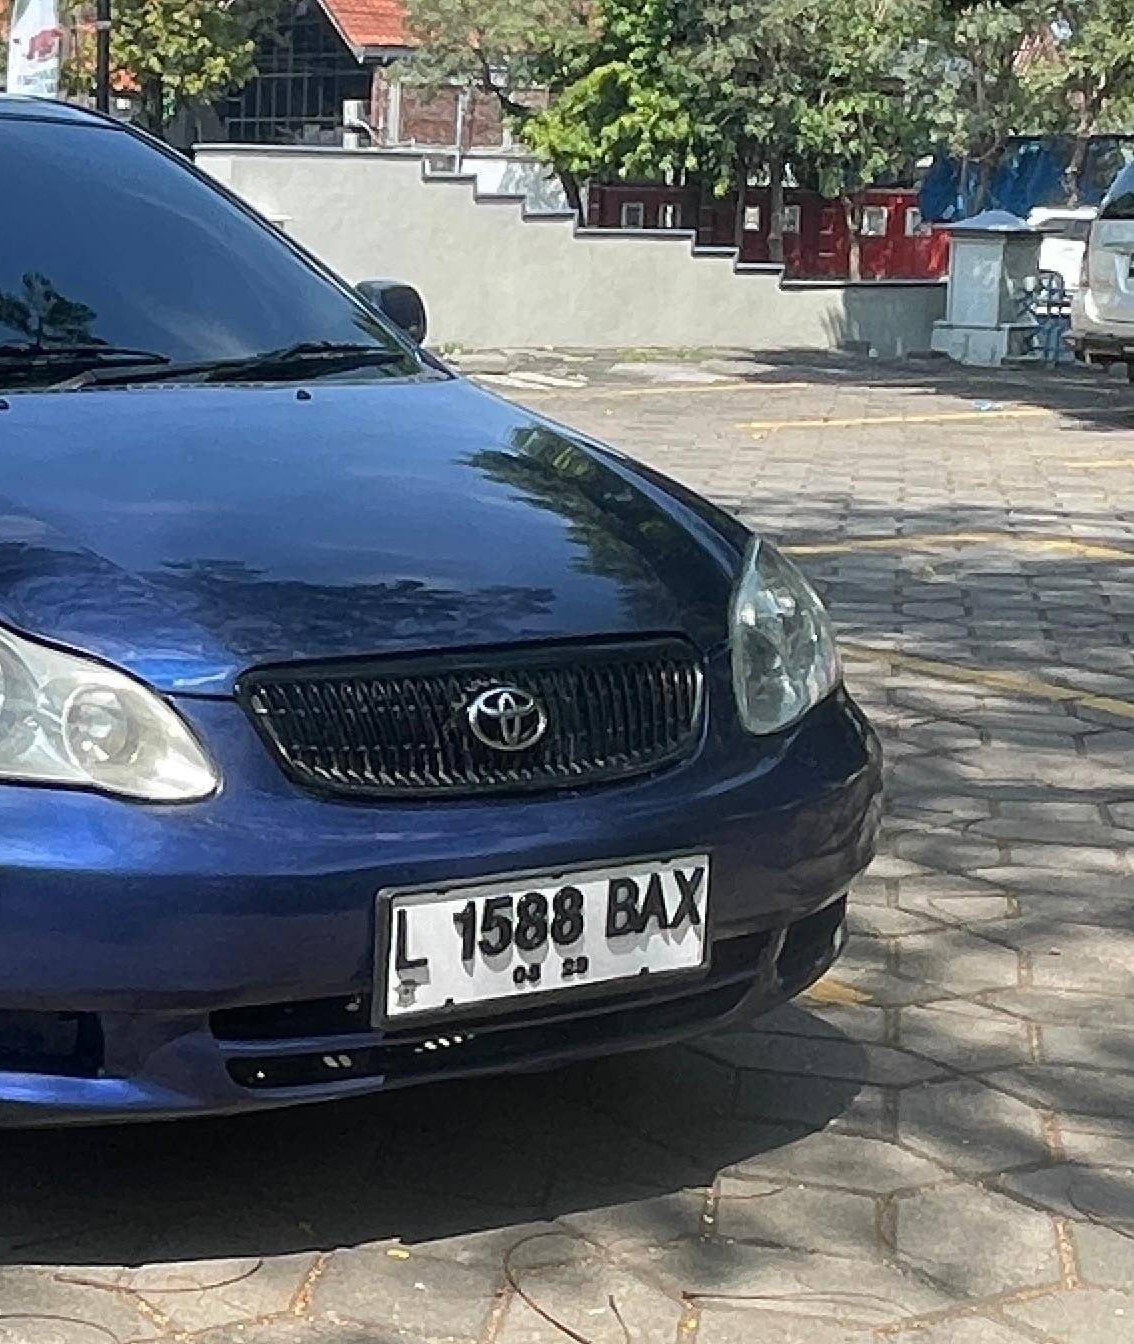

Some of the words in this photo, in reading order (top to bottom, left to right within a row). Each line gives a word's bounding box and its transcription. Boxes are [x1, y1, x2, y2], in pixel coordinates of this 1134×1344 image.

[396, 909, 428, 970] L
[453, 886, 584, 960] 1588
[605, 867, 704, 937] BAX
